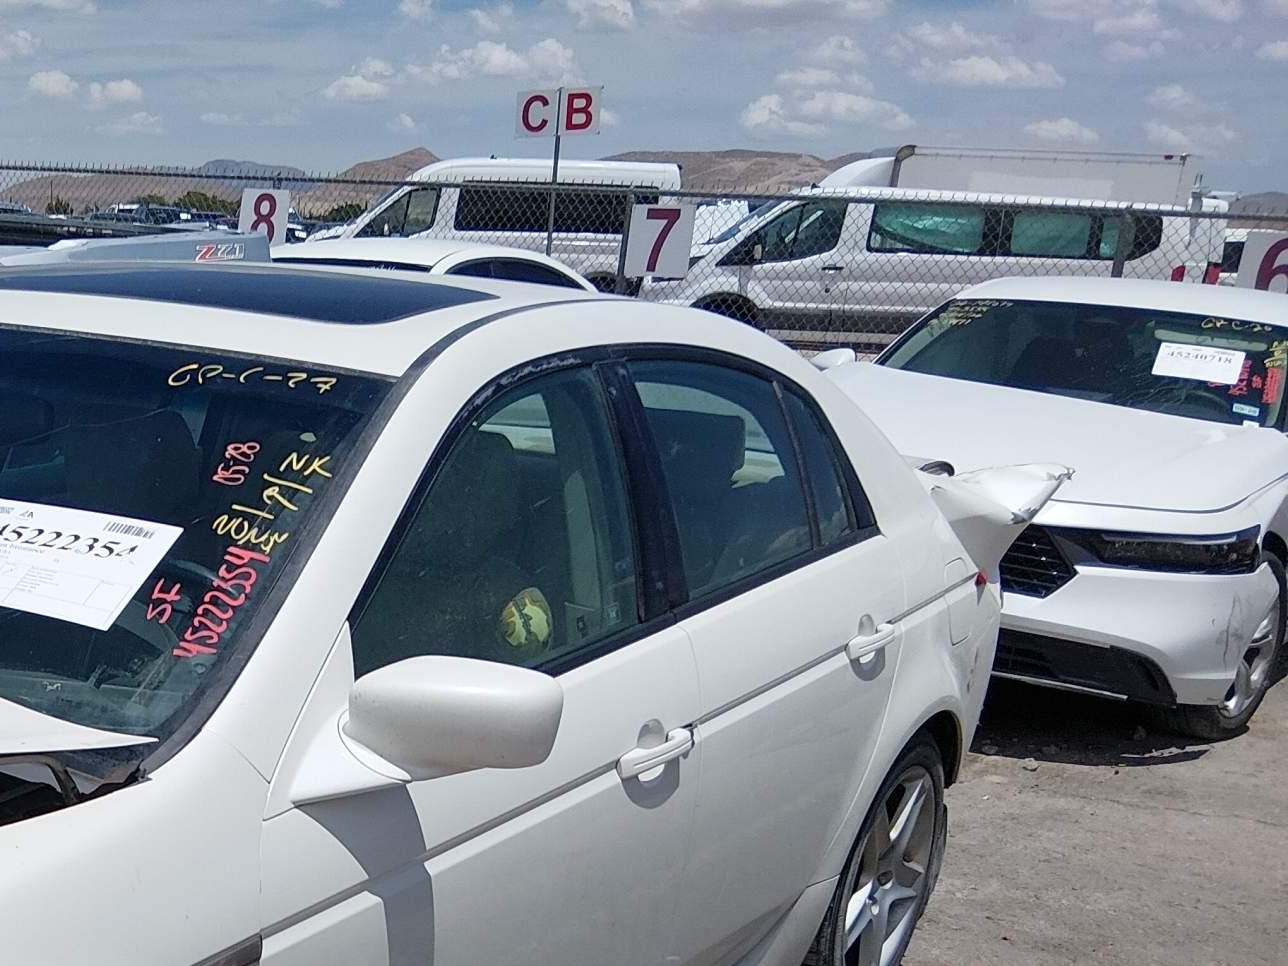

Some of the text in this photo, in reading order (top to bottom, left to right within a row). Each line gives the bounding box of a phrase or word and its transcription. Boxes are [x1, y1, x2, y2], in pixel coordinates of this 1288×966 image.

[521, 94, 550, 132] C
[565, 92, 593, 131] B
[250, 192, 277, 243] 8
[646, 208, 681, 273] 7
[146, 577, 182, 624] SF
